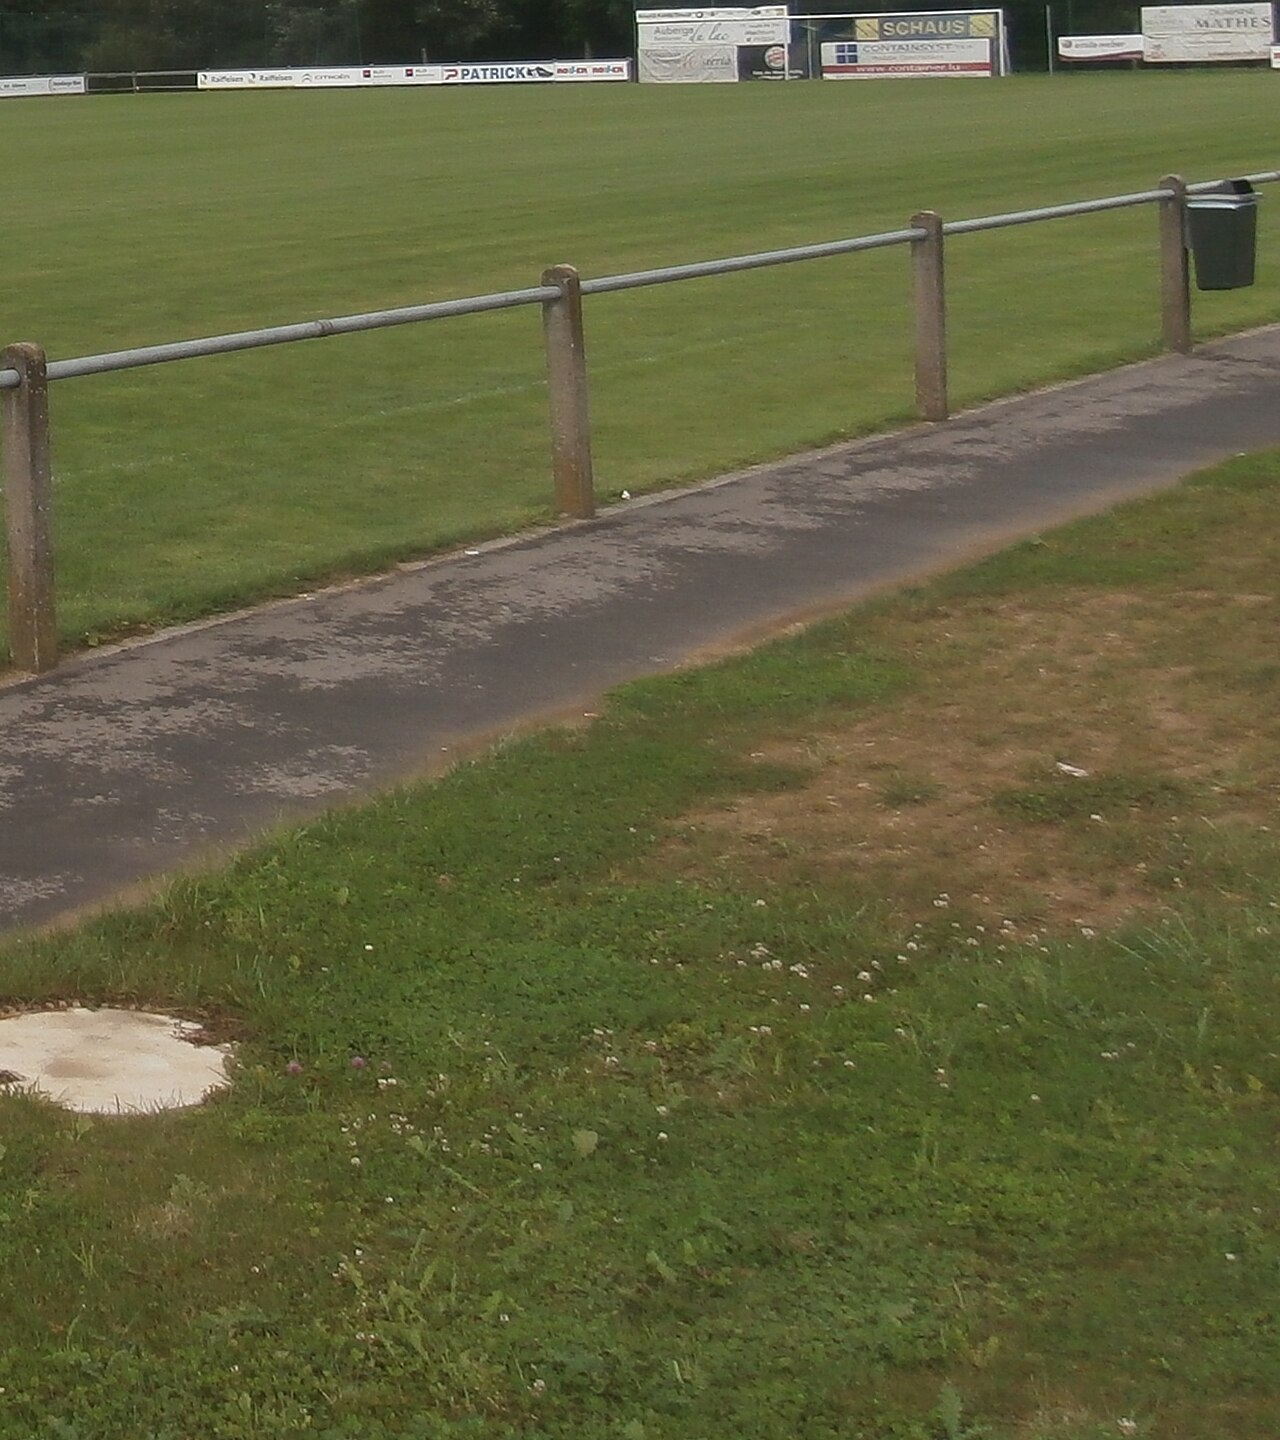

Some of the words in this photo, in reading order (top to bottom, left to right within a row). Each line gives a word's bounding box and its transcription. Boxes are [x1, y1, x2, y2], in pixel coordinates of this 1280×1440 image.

[883, 20, 965, 36] SCHAUS
[1195, 16, 1271, 28] MATHES
[211, 74, 244, 83] Raiffeisen
[259, 73, 293, 82] Raiffeisen
[461, 66, 526, 80] PATRICK
